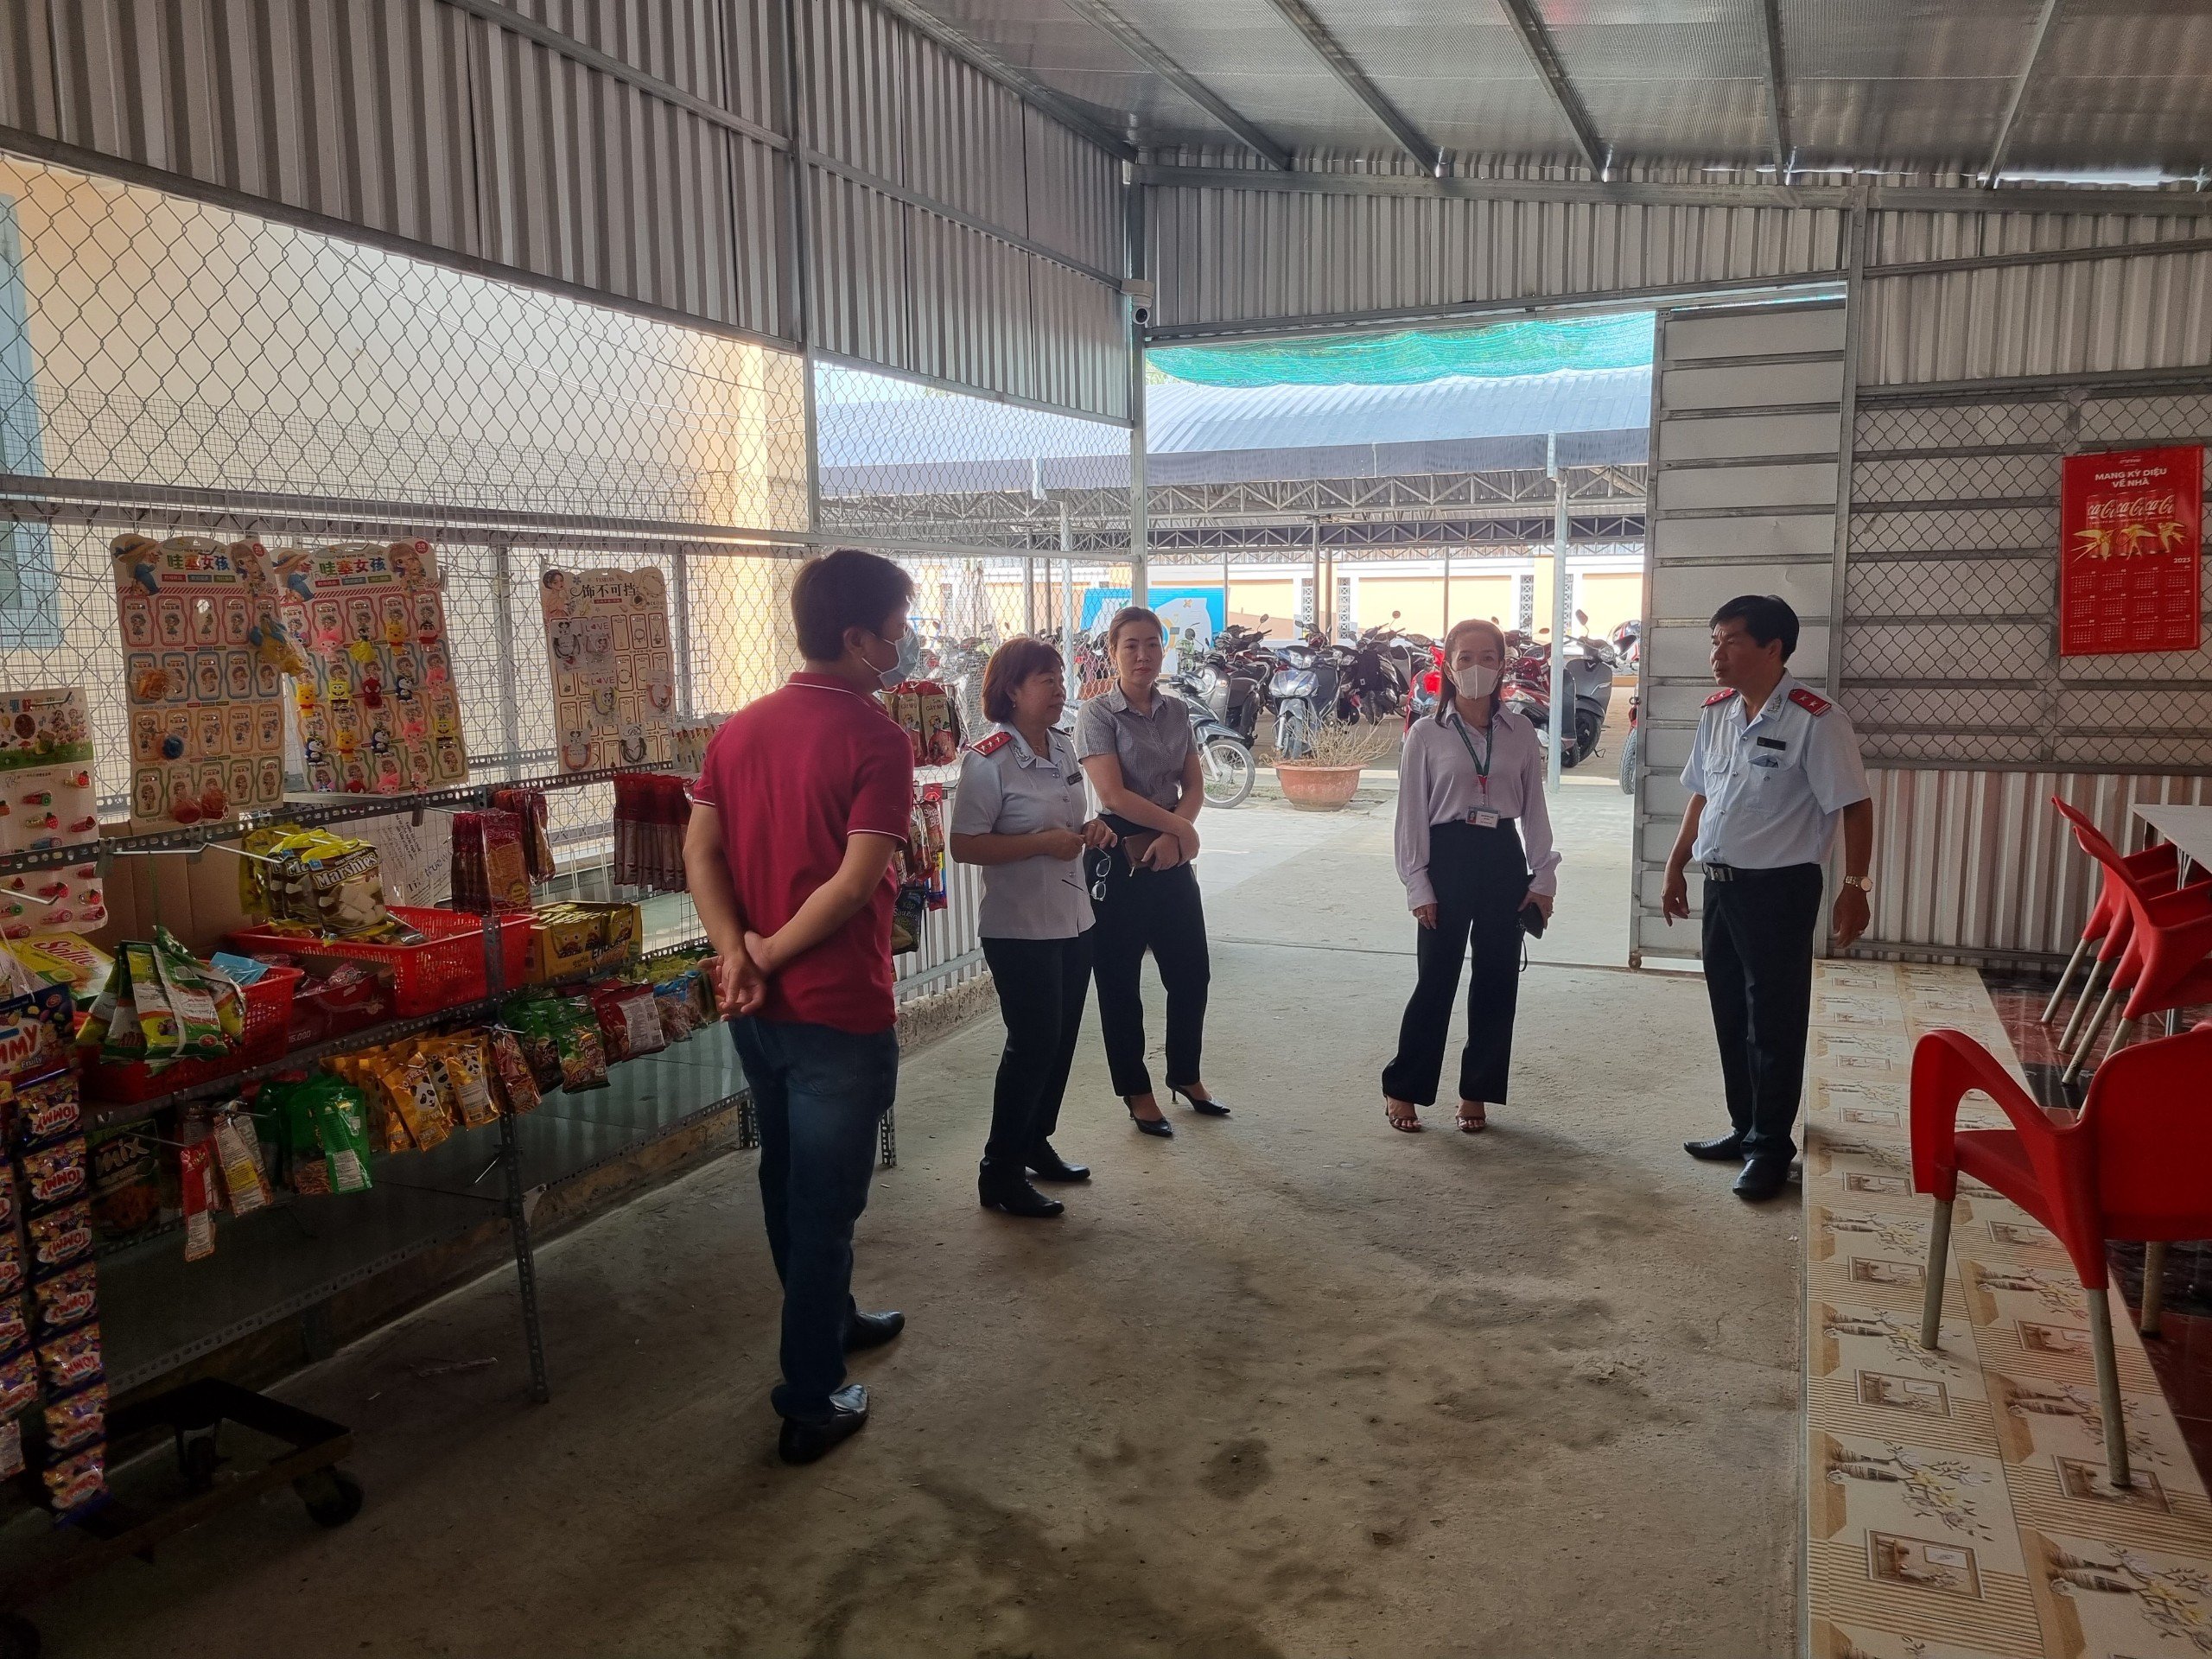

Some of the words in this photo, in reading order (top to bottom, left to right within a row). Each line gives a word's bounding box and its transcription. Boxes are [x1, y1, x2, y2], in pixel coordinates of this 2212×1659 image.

[2094, 472, 2126, 481] MANG
[315, 854, 378, 889] Marshies
[31, 939, 97, 967] Solite
[21, 1055, 43, 1070] Fruity
[35, 1106, 79, 1132] TOMMY
[41, 1169, 84, 1197] TOMMY
[47, 1232, 89, 1257] TOMMY
